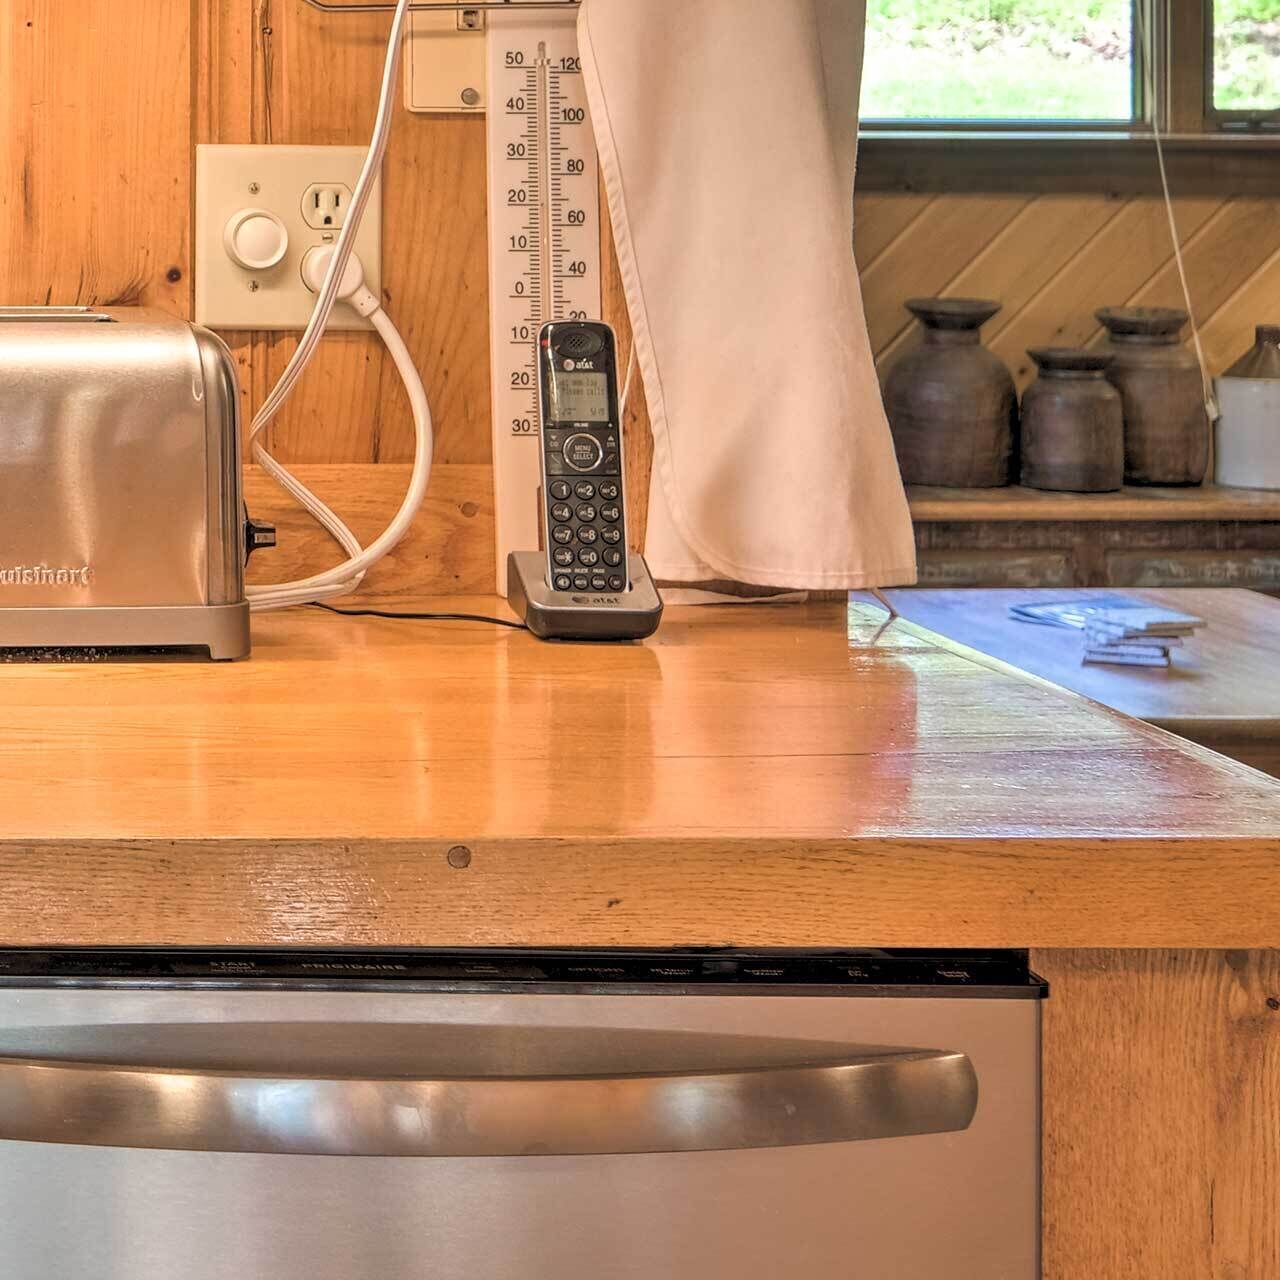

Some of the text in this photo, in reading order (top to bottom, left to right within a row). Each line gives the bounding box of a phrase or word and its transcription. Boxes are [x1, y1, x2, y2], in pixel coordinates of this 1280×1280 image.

[505, 51, 524, 65] 50
[506, 97, 525, 111] 40
[561, 108, 585, 121] 100
[507, 143, 525, 156] 30
[567, 159, 584, 172] 80
[507, 189, 526, 202] 20
[567, 210, 585, 224] 60
[510, 236, 527, 249] 10
[569, 261, 586, 274] 40
[515, 281, 524, 295] 0
[511, 326, 529, 339] 10
[511, 372, 529, 385] 20
[512, 419, 530, 432] 30
[561, 485, 567, 495] 1
[586, 485, 593, 496] 2
[610, 486, 617, 496] 3
[562, 508, 569, 518] 4
[587, 507, 594, 518] 5
[611, 508, 618, 518] 6
[564, 530, 571, 540] 7
[589, 530, 596, 540] 8
[613, 530, 620, 540] 9
[589, 552, 596, 562] 0
